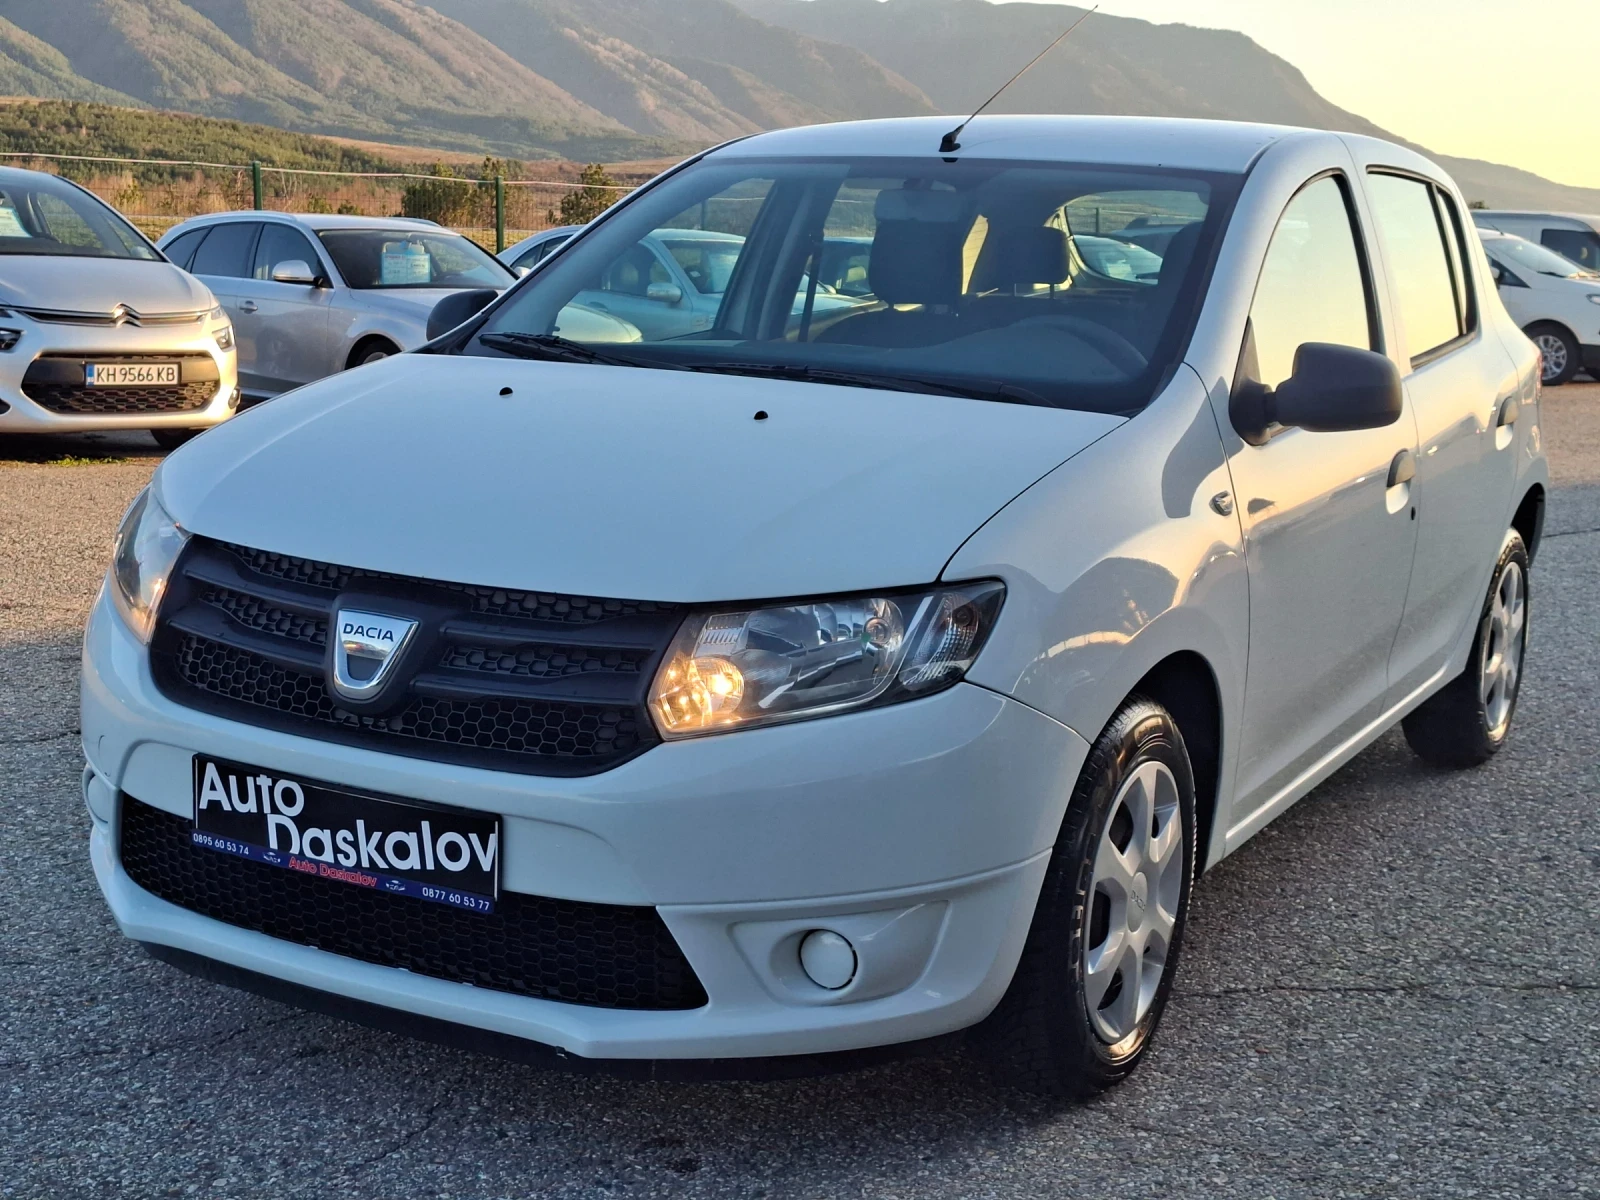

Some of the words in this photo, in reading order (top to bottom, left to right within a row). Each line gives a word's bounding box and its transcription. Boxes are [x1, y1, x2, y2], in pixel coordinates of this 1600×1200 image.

[96, 367, 117, 382] KH
[119, 367, 154, 382] 9566
[157, 367, 175, 382] KB
[343, 623, 394, 642] DACIA
[199, 762, 305, 817] Auto
[193, 833, 213, 846] 0895
[214, 839, 225, 849] 60
[226, 843, 237, 852] 53
[239, 845, 250, 856] 74
[267, 813, 497, 872] Daskalov
[289, 856, 317, 873] Auto
[319, 863, 378, 887] Daskalov
[422, 887, 446, 900] 0877
[449, 893, 461, 904] 60
[463, 896, 475, 908] 53
[478, 900, 490, 911] 77
